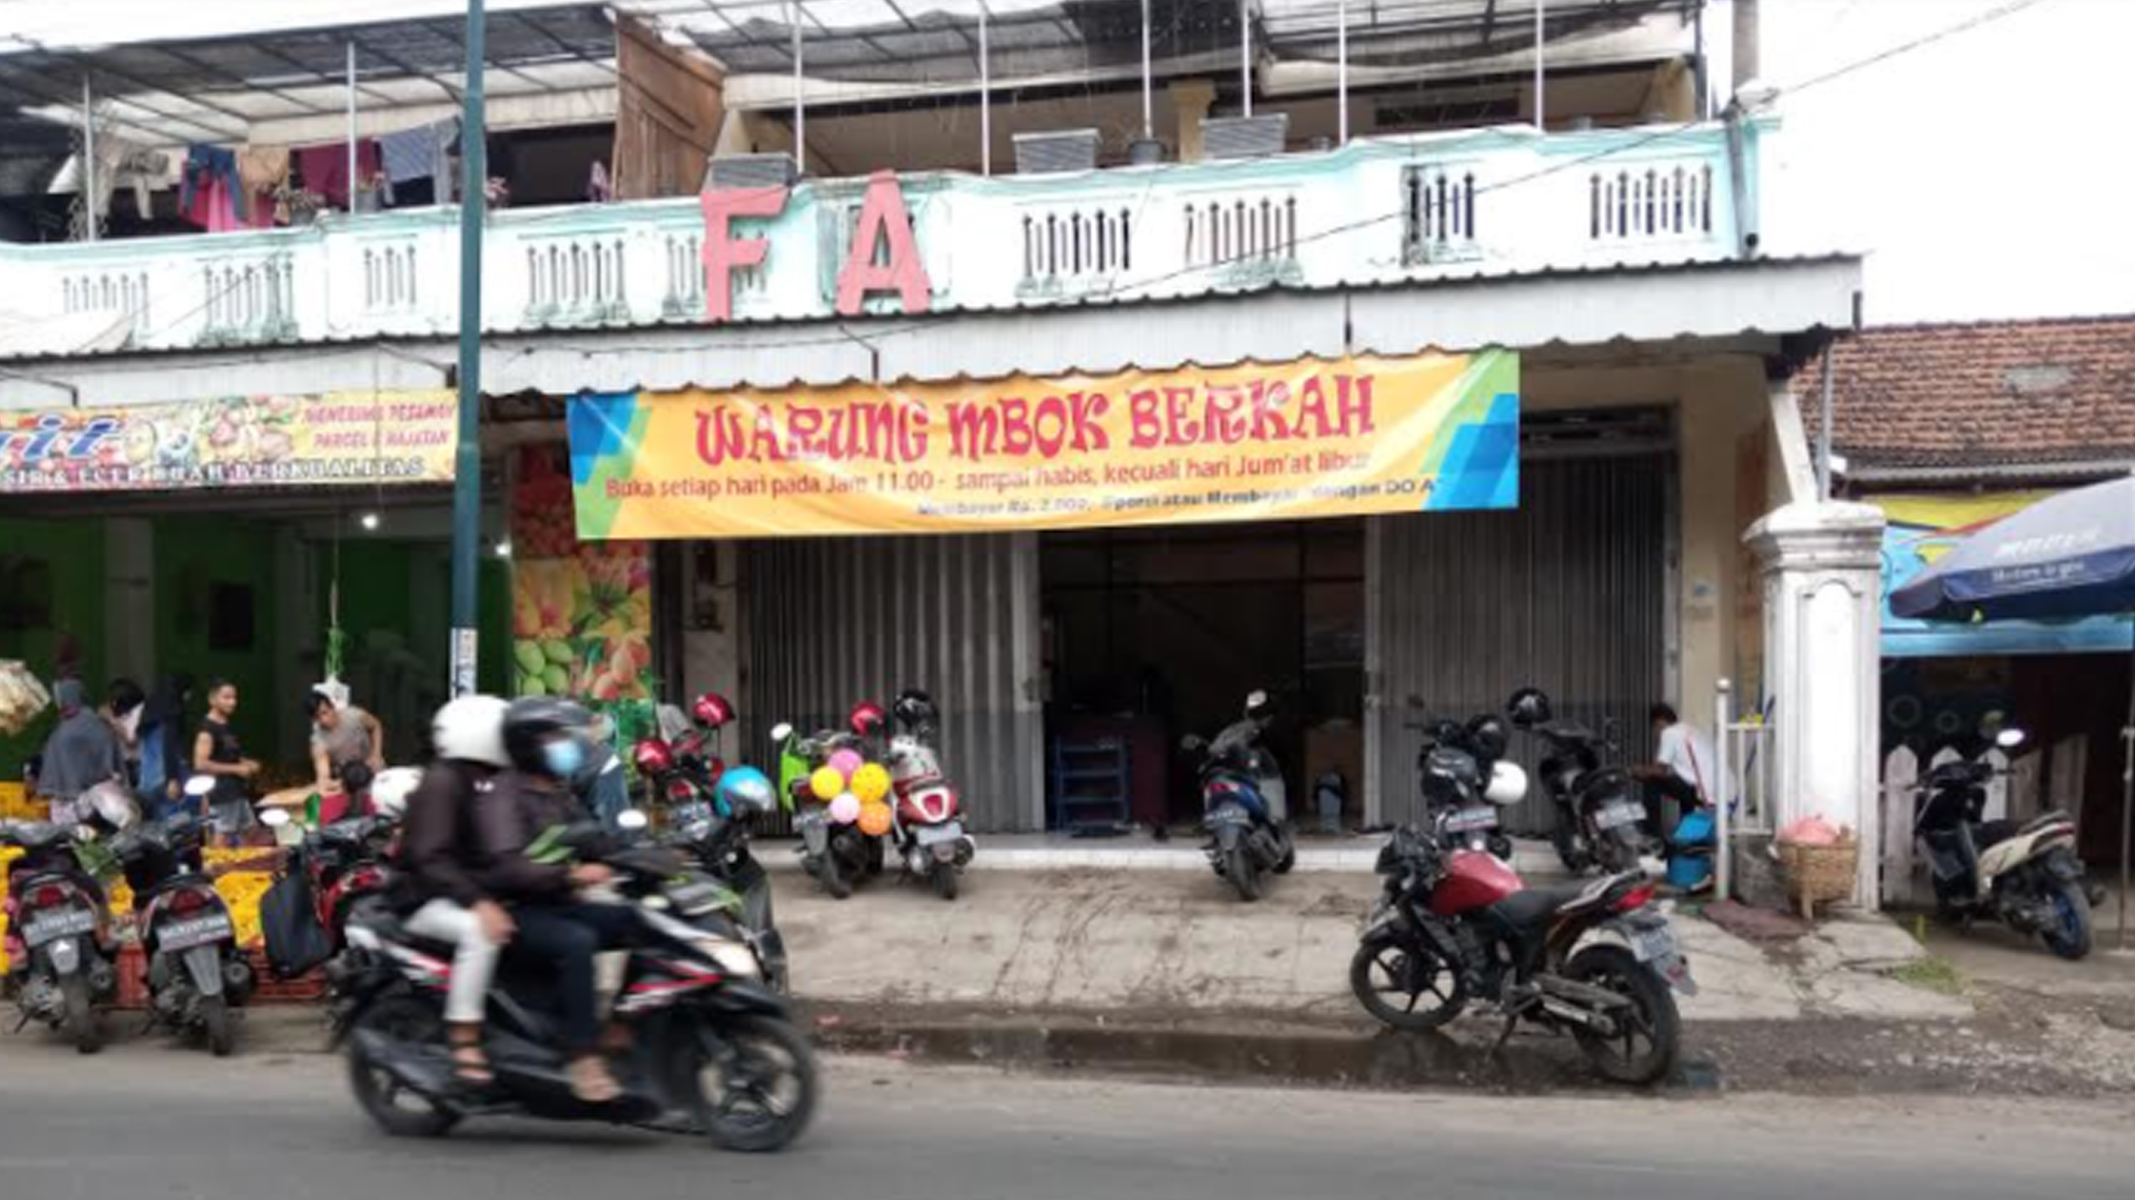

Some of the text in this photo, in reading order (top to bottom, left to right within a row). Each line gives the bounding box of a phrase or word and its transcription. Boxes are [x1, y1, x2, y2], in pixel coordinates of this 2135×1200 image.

[701, 169, 932, 322] F A
[695, 374, 1374, 466] WARUNG MBOK BERKAH
[606, 476, 653, 498] Buka
[660, 476, 721, 501] setiap
[726, 475, 767, 496] hari
[771, 475, 820, 500] pada
[876, 470, 933, 491] 11.00
[956, 467, 1031, 494] sampai
[1036, 463, 1097, 487] habis,
[1104, 459, 1179, 484] kecuali
[1186, 457, 1229, 478] hari
